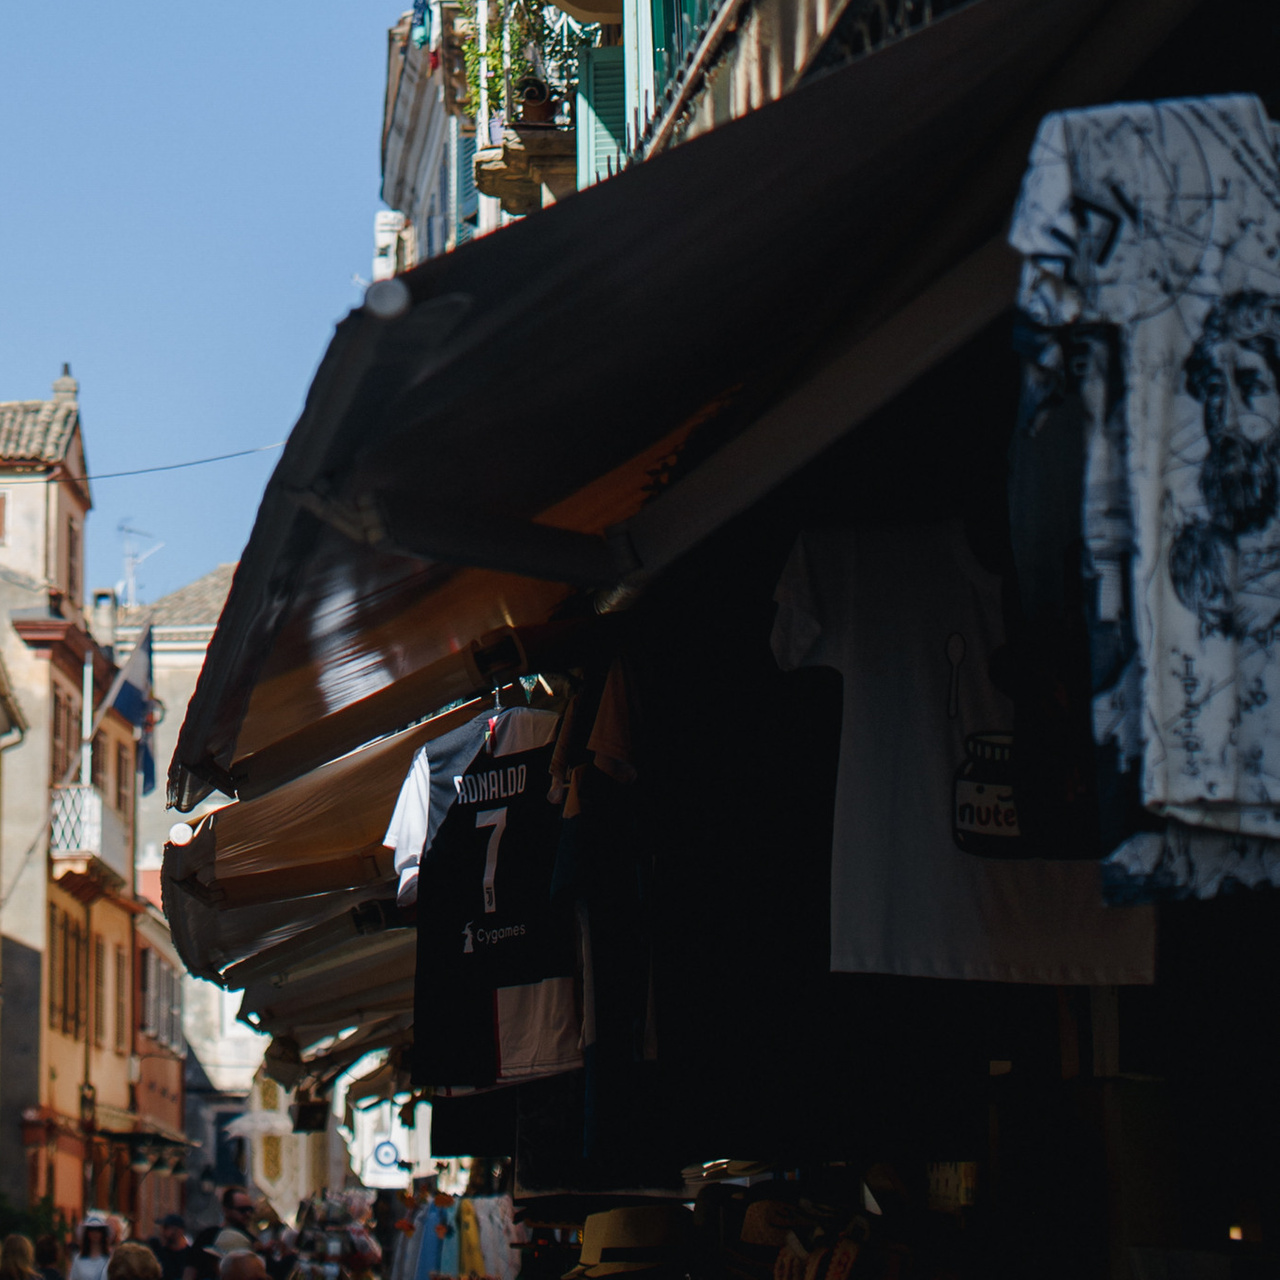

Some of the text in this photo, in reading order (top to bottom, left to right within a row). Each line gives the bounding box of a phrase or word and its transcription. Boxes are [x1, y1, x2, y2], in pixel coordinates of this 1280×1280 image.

[453, 763, 527, 805] RONALDO
[959, 802, 1016, 827] nute
[475, 806, 508, 914] 7
[476, 923, 526, 944] Cygames
